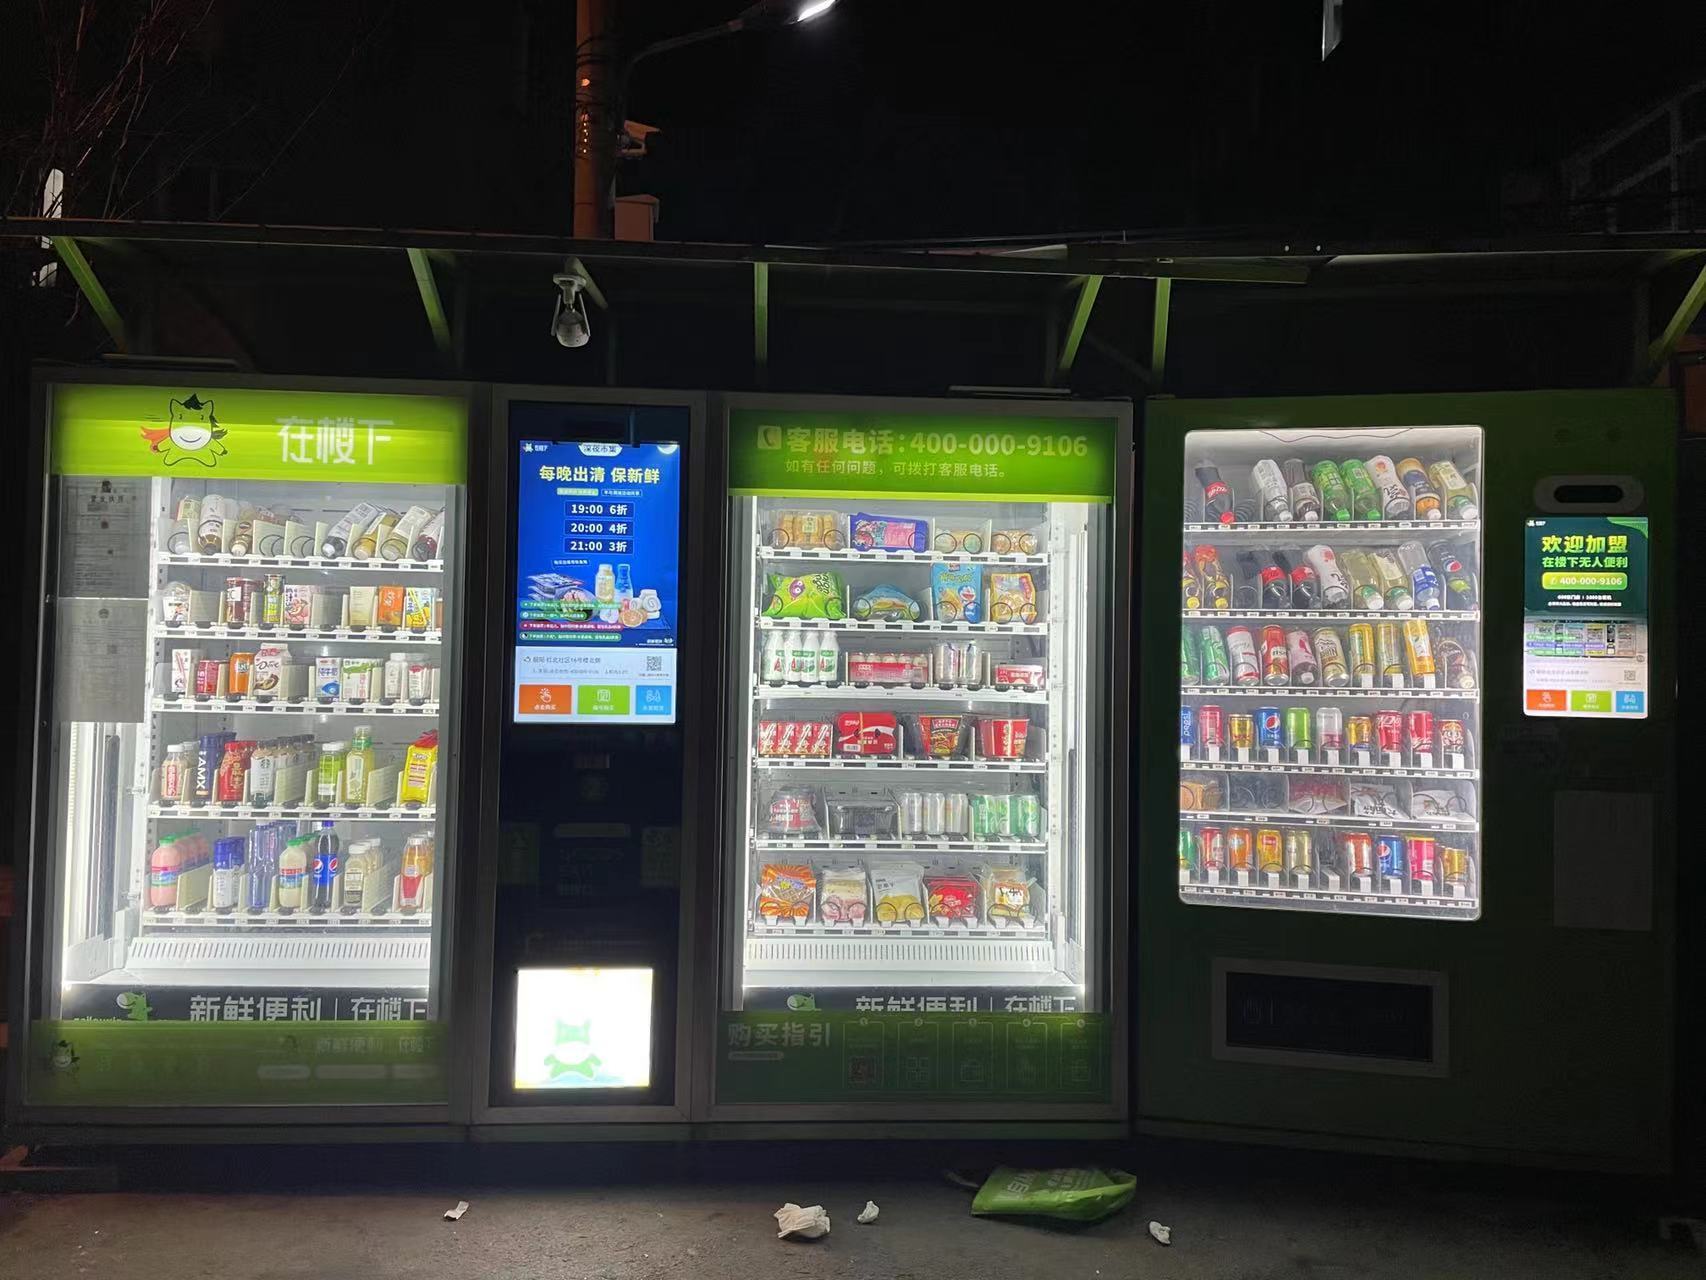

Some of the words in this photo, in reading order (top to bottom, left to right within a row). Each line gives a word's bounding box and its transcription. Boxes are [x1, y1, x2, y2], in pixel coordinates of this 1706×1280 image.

[276, 416, 396, 465] 在楼下
[539, 465, 605, 483] 每晚出清
[611, 467, 660, 484] 保新鲜
[571, 504, 603, 514] 19:00
[609, 504, 628, 515] 6折
[570, 523, 603, 533] 20:00
[608, 523, 627, 534] 4折
[570, 541, 603, 551] 21:00
[608, 541, 627, 552] 3折
[1542, 535, 1628, 553] 欢迎加盟
[1542, 556, 1628, 568] 在楼下无人便利
[1559, 577, 1622, 585] 400-000-9106
[190, 995, 320, 1021] 新鲜便利
[351, 997, 428, 1021] 在楼下
[728, 1022, 831, 1048] 购买指引
